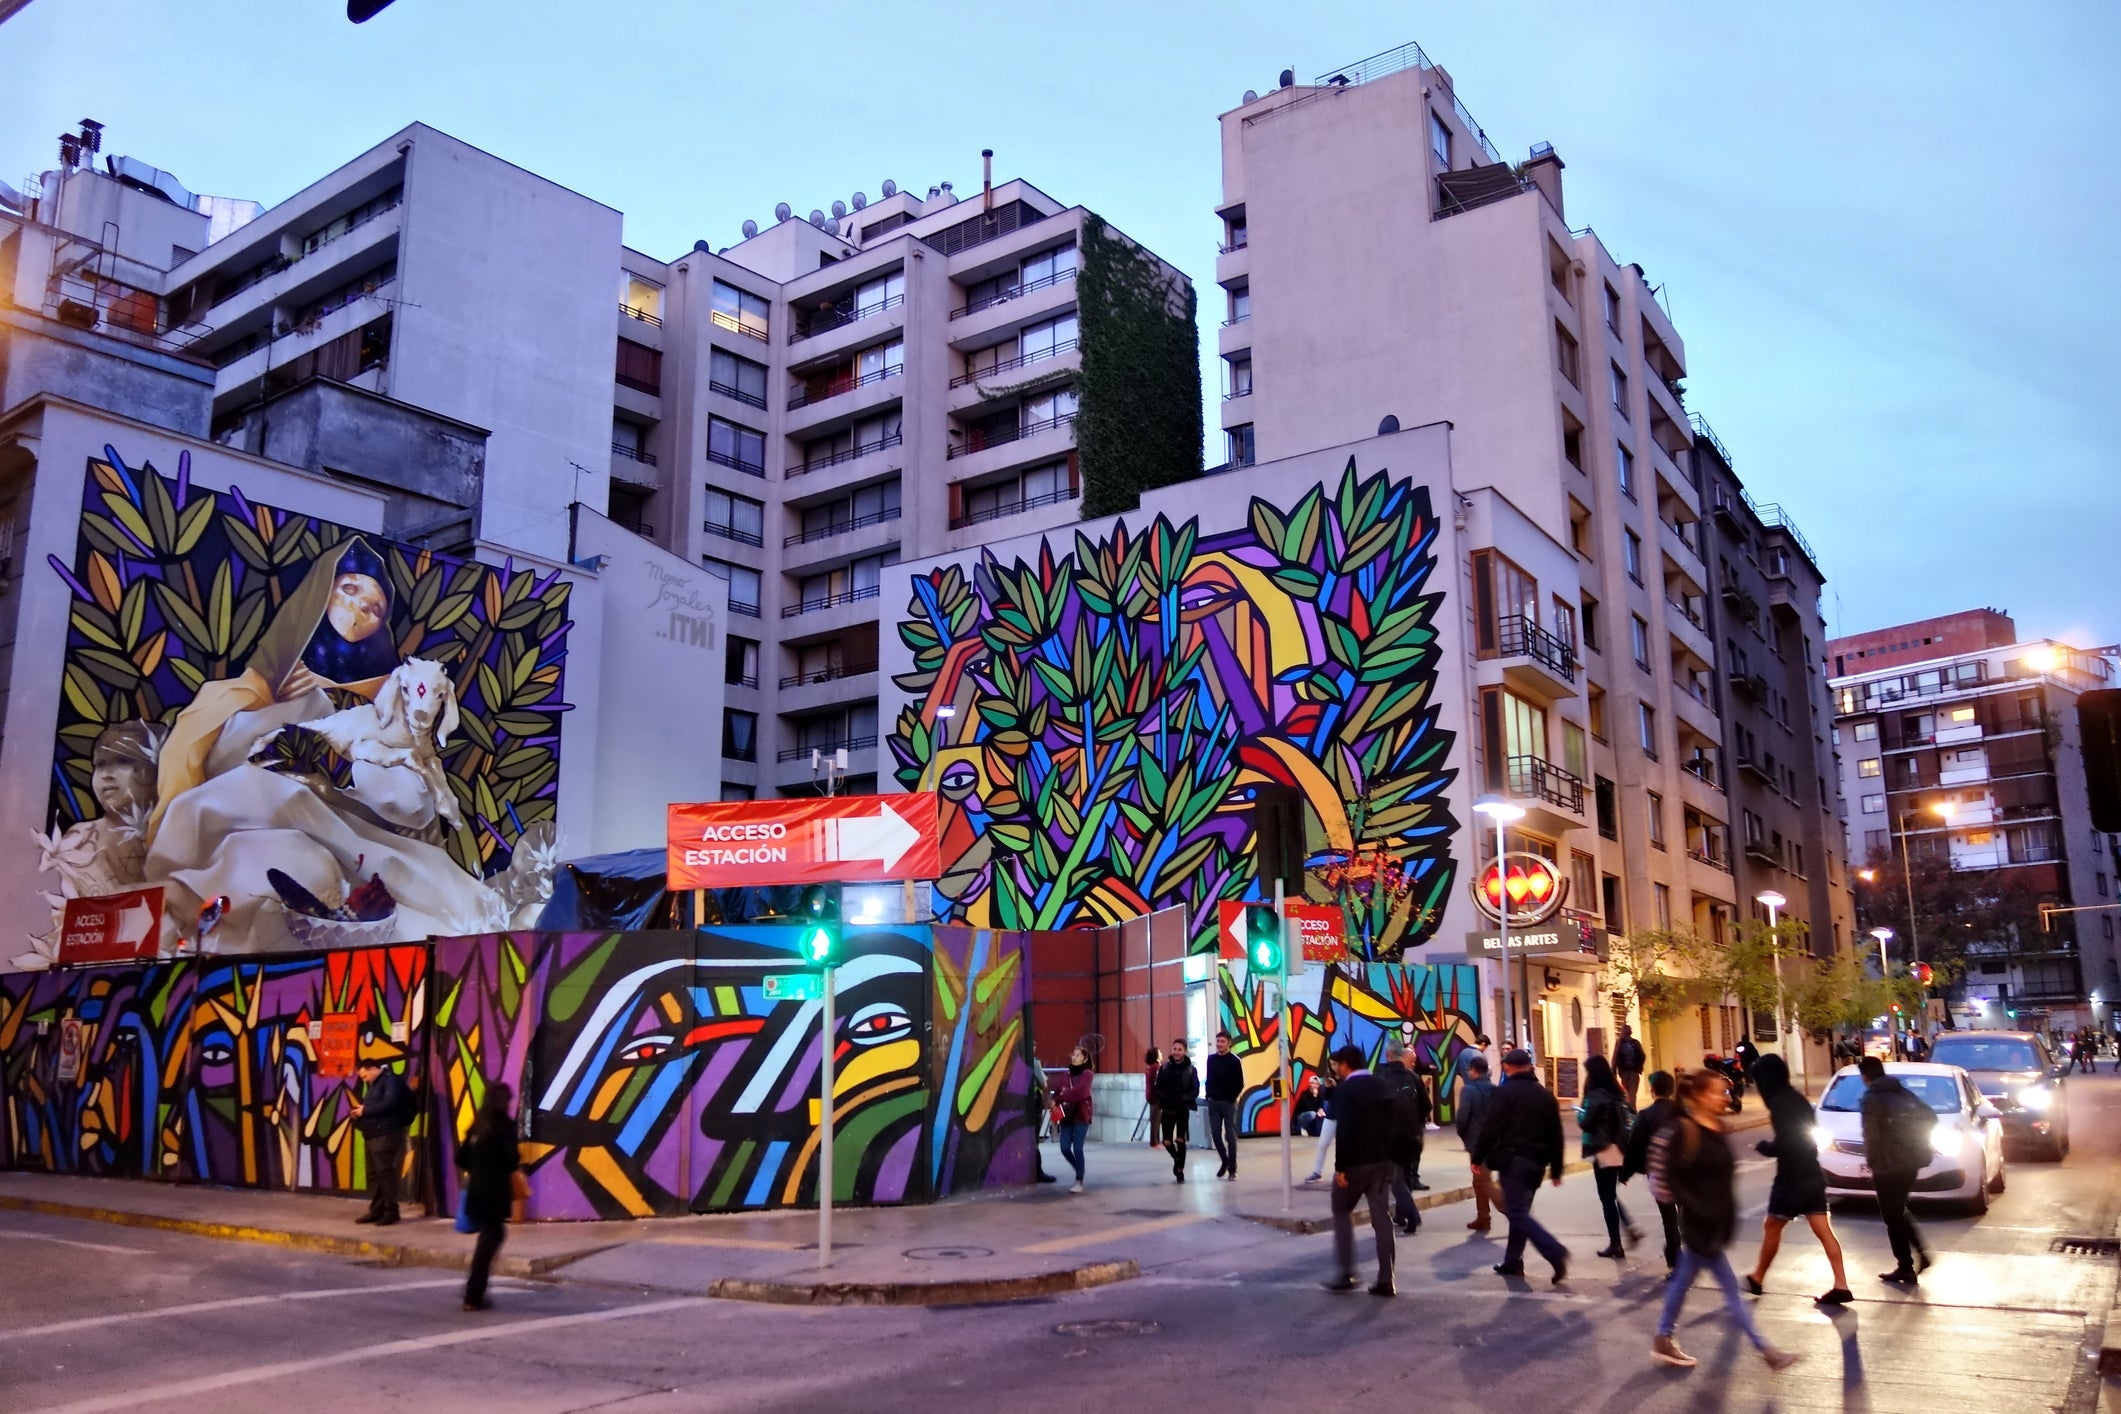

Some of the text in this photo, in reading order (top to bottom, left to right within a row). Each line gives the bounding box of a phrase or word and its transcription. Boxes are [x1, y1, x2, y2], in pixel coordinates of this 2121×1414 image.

[702, 823, 787, 842] ACCESO
[684, 844, 787, 866] ESTACIÓN
[74, 913, 105, 928] ACCESO
[66, 929, 105, 946] ESTACIÓN
[1483, 933, 1559, 949] BELAS ARTES
